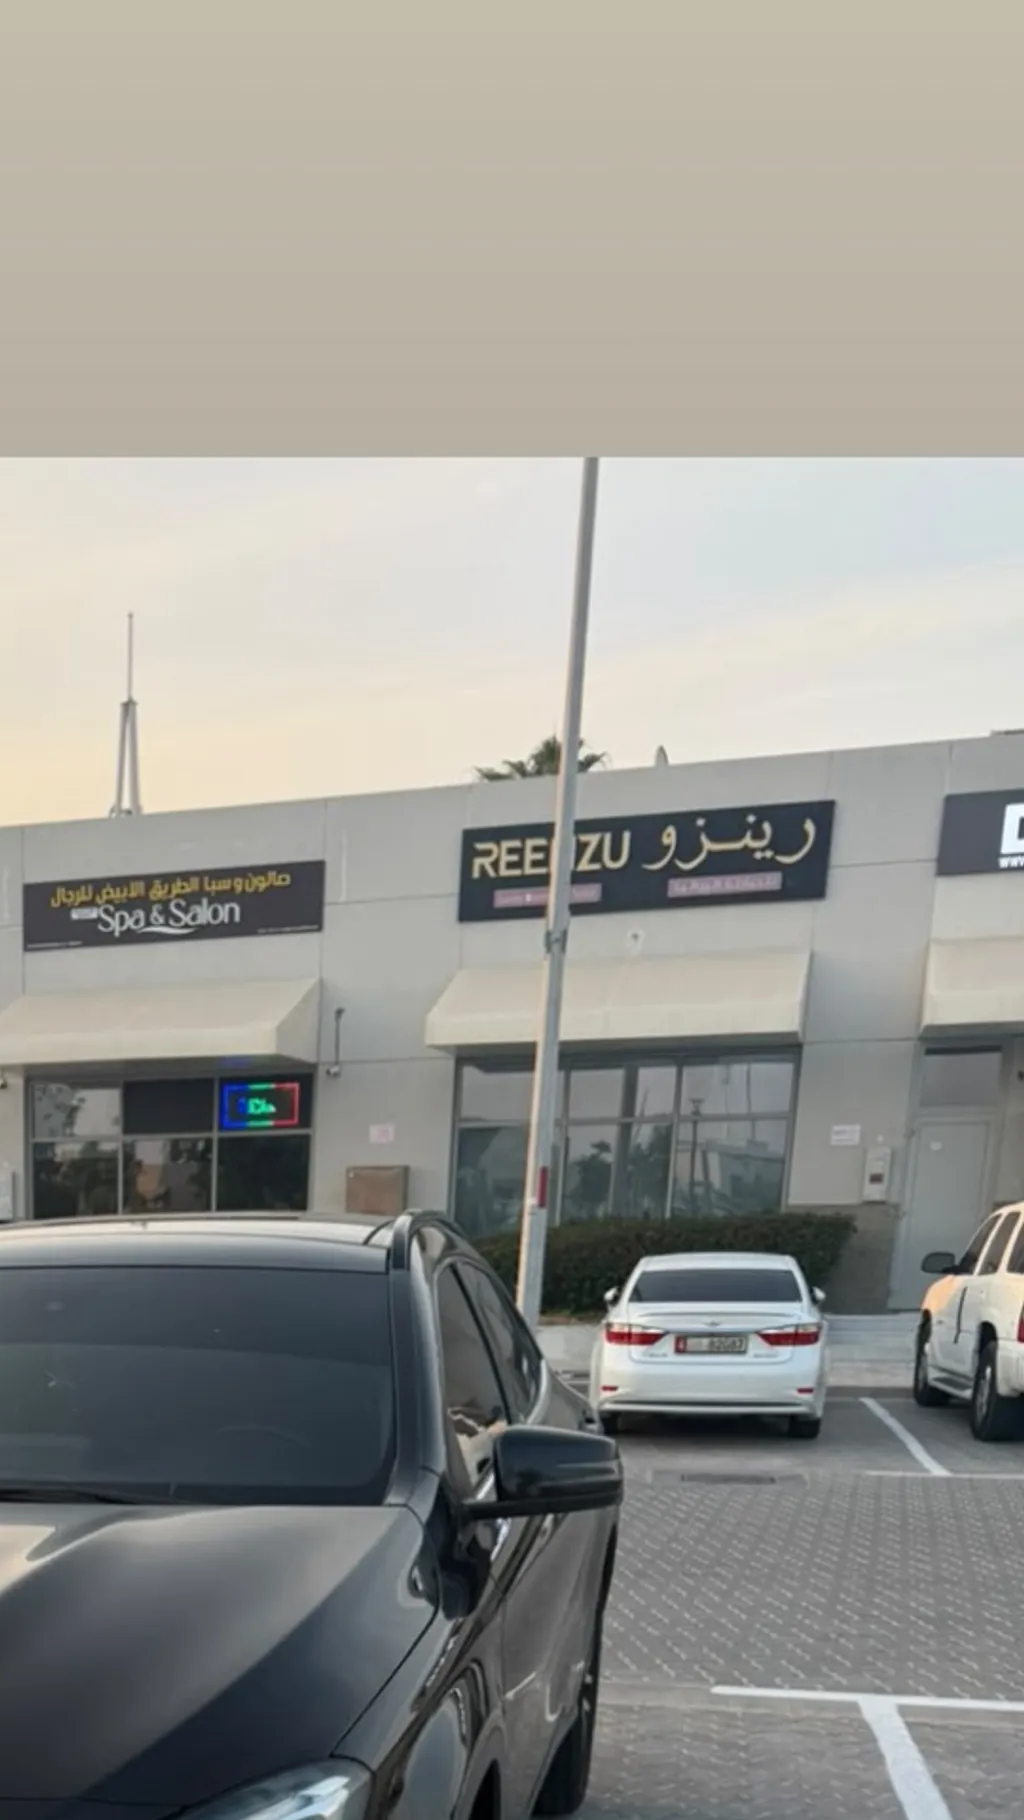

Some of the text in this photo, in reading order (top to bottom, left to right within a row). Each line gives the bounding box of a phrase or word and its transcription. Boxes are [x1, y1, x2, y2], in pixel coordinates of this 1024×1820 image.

[472, 829, 631, 879] REEZU
[641, 814, 816, 870] رينزو
[50, 884, 94, 908] للرجال
[97, 904, 145, 938] Spa
[149, 903, 165, 925] &
[168, 897, 241, 928] Salon
